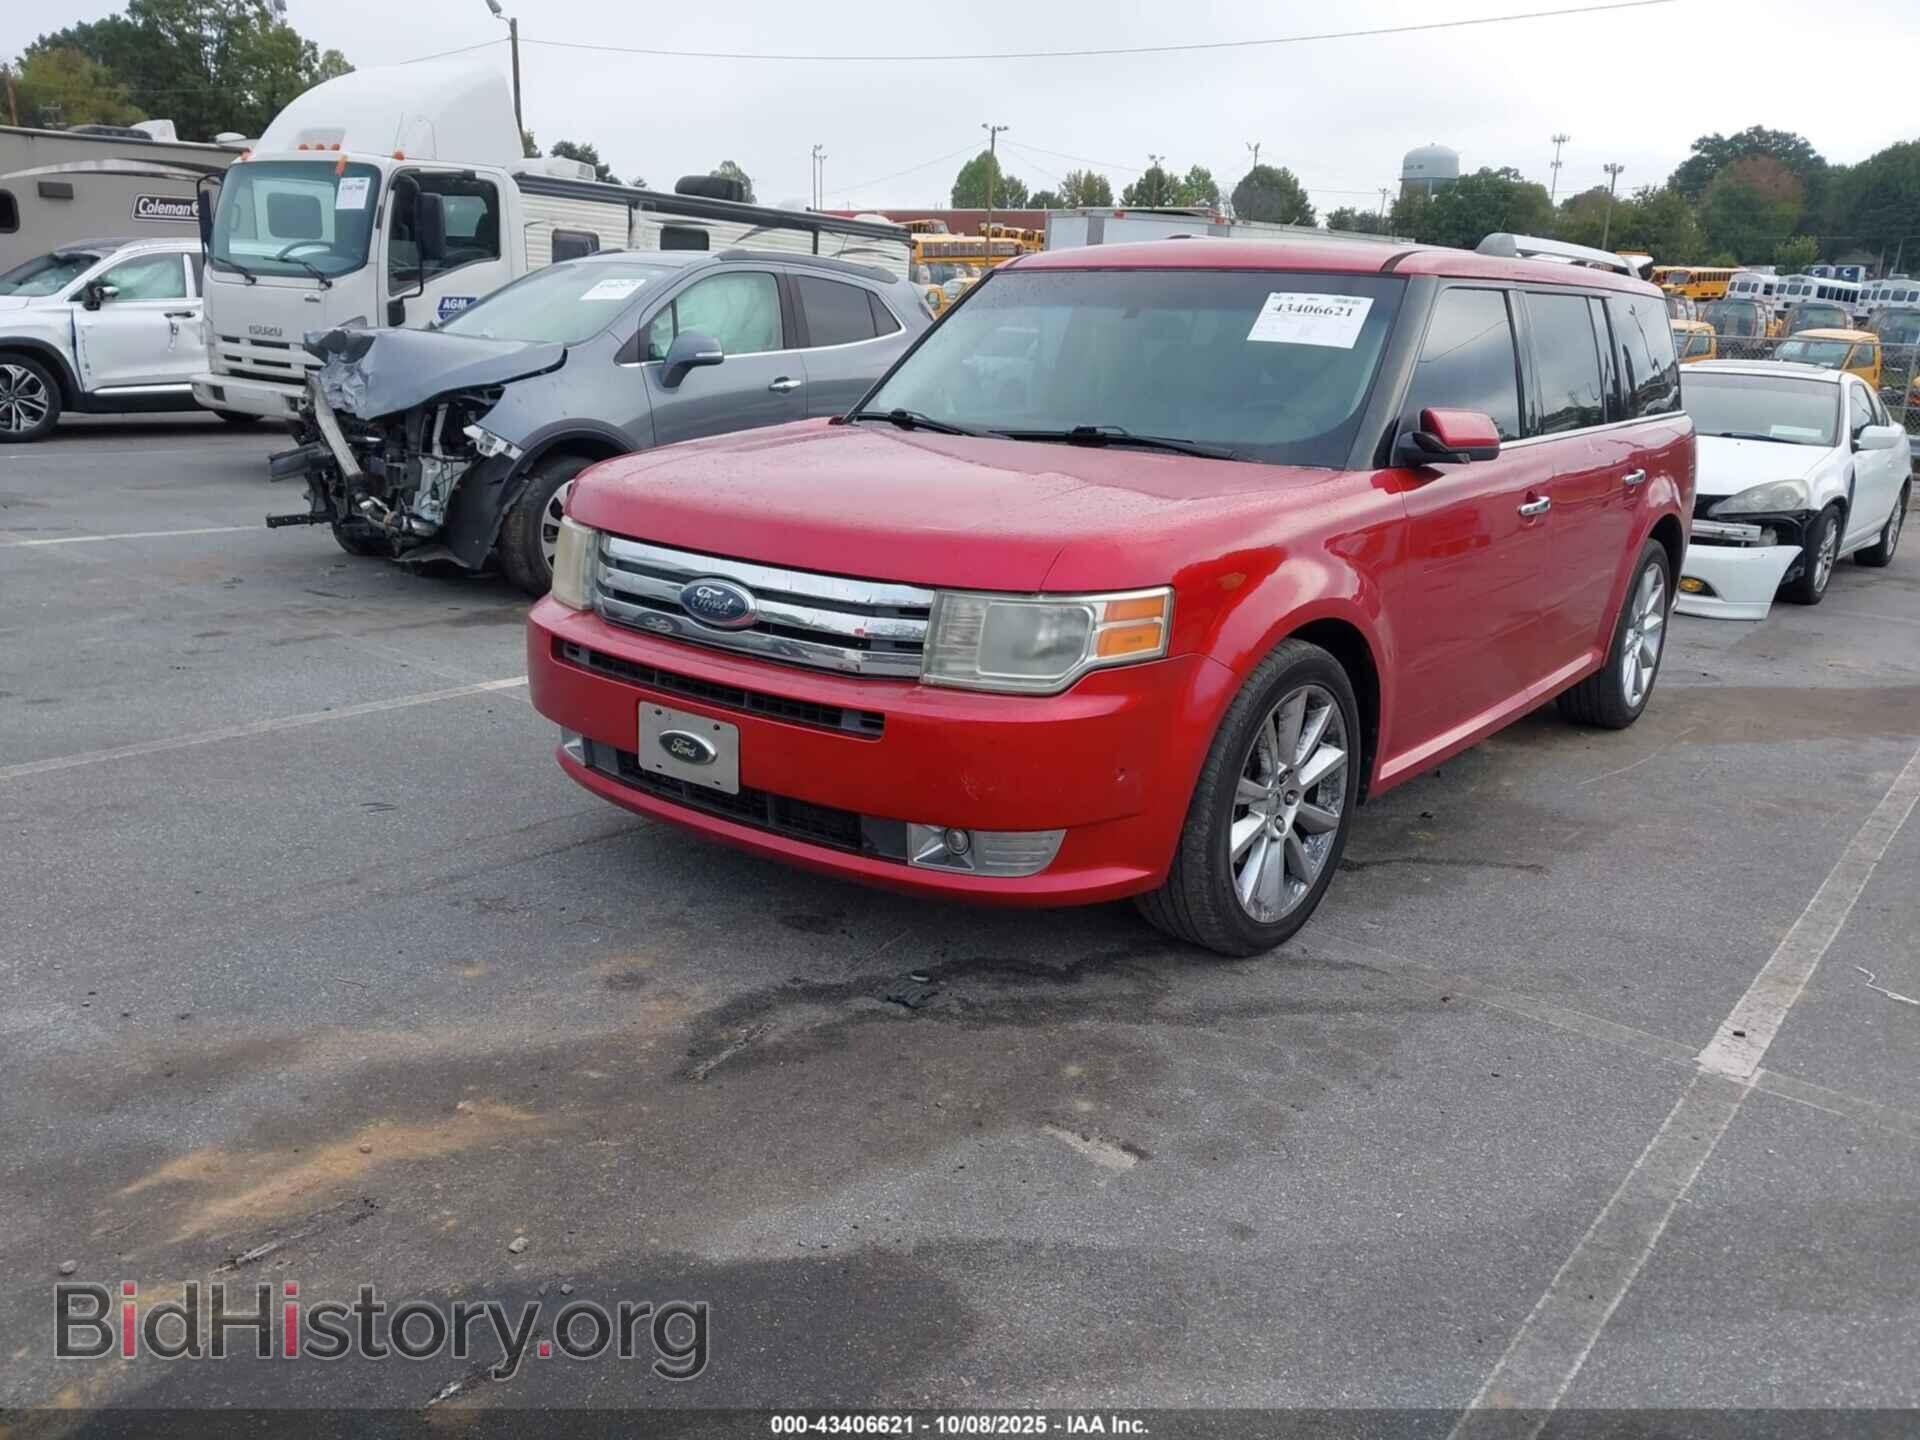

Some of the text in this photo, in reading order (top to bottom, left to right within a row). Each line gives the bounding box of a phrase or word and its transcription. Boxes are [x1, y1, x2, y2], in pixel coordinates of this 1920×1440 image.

[138, 197, 191, 216] Coleman
[1273, 303, 1353, 318] 43406621
[248, 324, 283, 337] ISUZU
[691, 586, 734, 611] Ford
[671, 737, 697, 758] Ford
